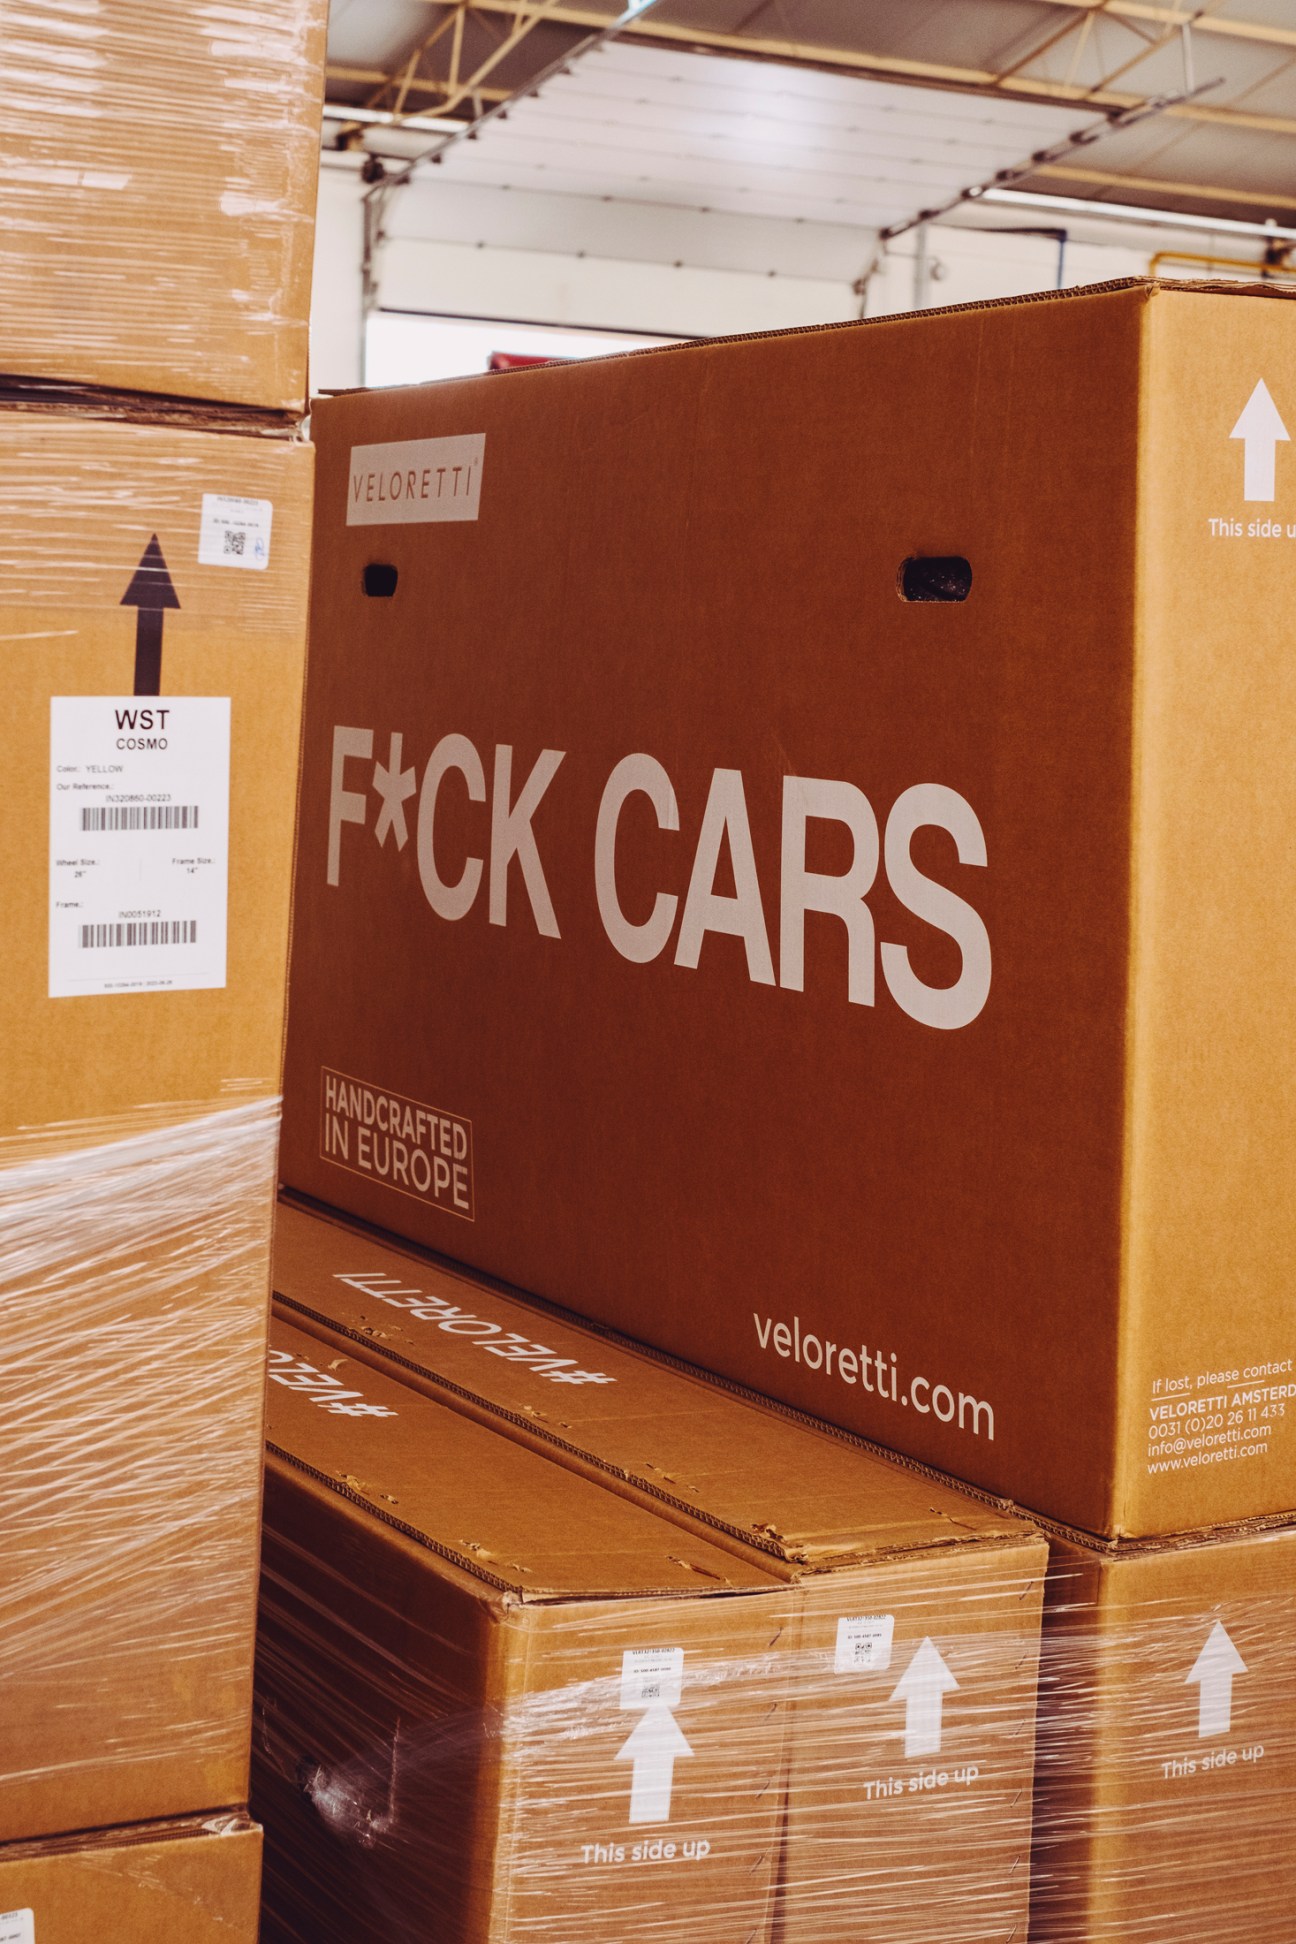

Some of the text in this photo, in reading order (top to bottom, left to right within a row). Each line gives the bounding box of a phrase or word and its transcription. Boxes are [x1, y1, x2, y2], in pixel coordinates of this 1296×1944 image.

[1208, 518, 1243, 537] This
[1247, 518, 1282, 538] side
[115, 709, 170, 730] WST
[116, 738, 168, 750] COSMO
[86, 764, 123, 773] YELLOW
[57, 783, 70, 791] Our
[172, 857, 195, 865] Frame
[595, 752, 992, 1030] CARS
[325, 1074, 468, 1161] HANDCRAFTED
[325, 1112, 470, 1210] IN EUROPE
[332, 1272, 618, 1385] #VELORETTI
[753, 1312, 994, 1441] veloretti.com
[1152, 1359, 1293, 1394] If lost, please contact
[1149, 1395, 1228, 1421] VELORETTI
[1149, 1403, 1286, 1440] 0031 (0)20 26 11 433
[1147, 1424, 1272, 1457] info@veloretti.com
[1147, 1443, 1268, 1475] www.veloretti.com
[1161, 1745, 1265, 1780] This side up
[863, 1766, 979, 1800] This side up
[580, 1839, 711, 1864] This side up
